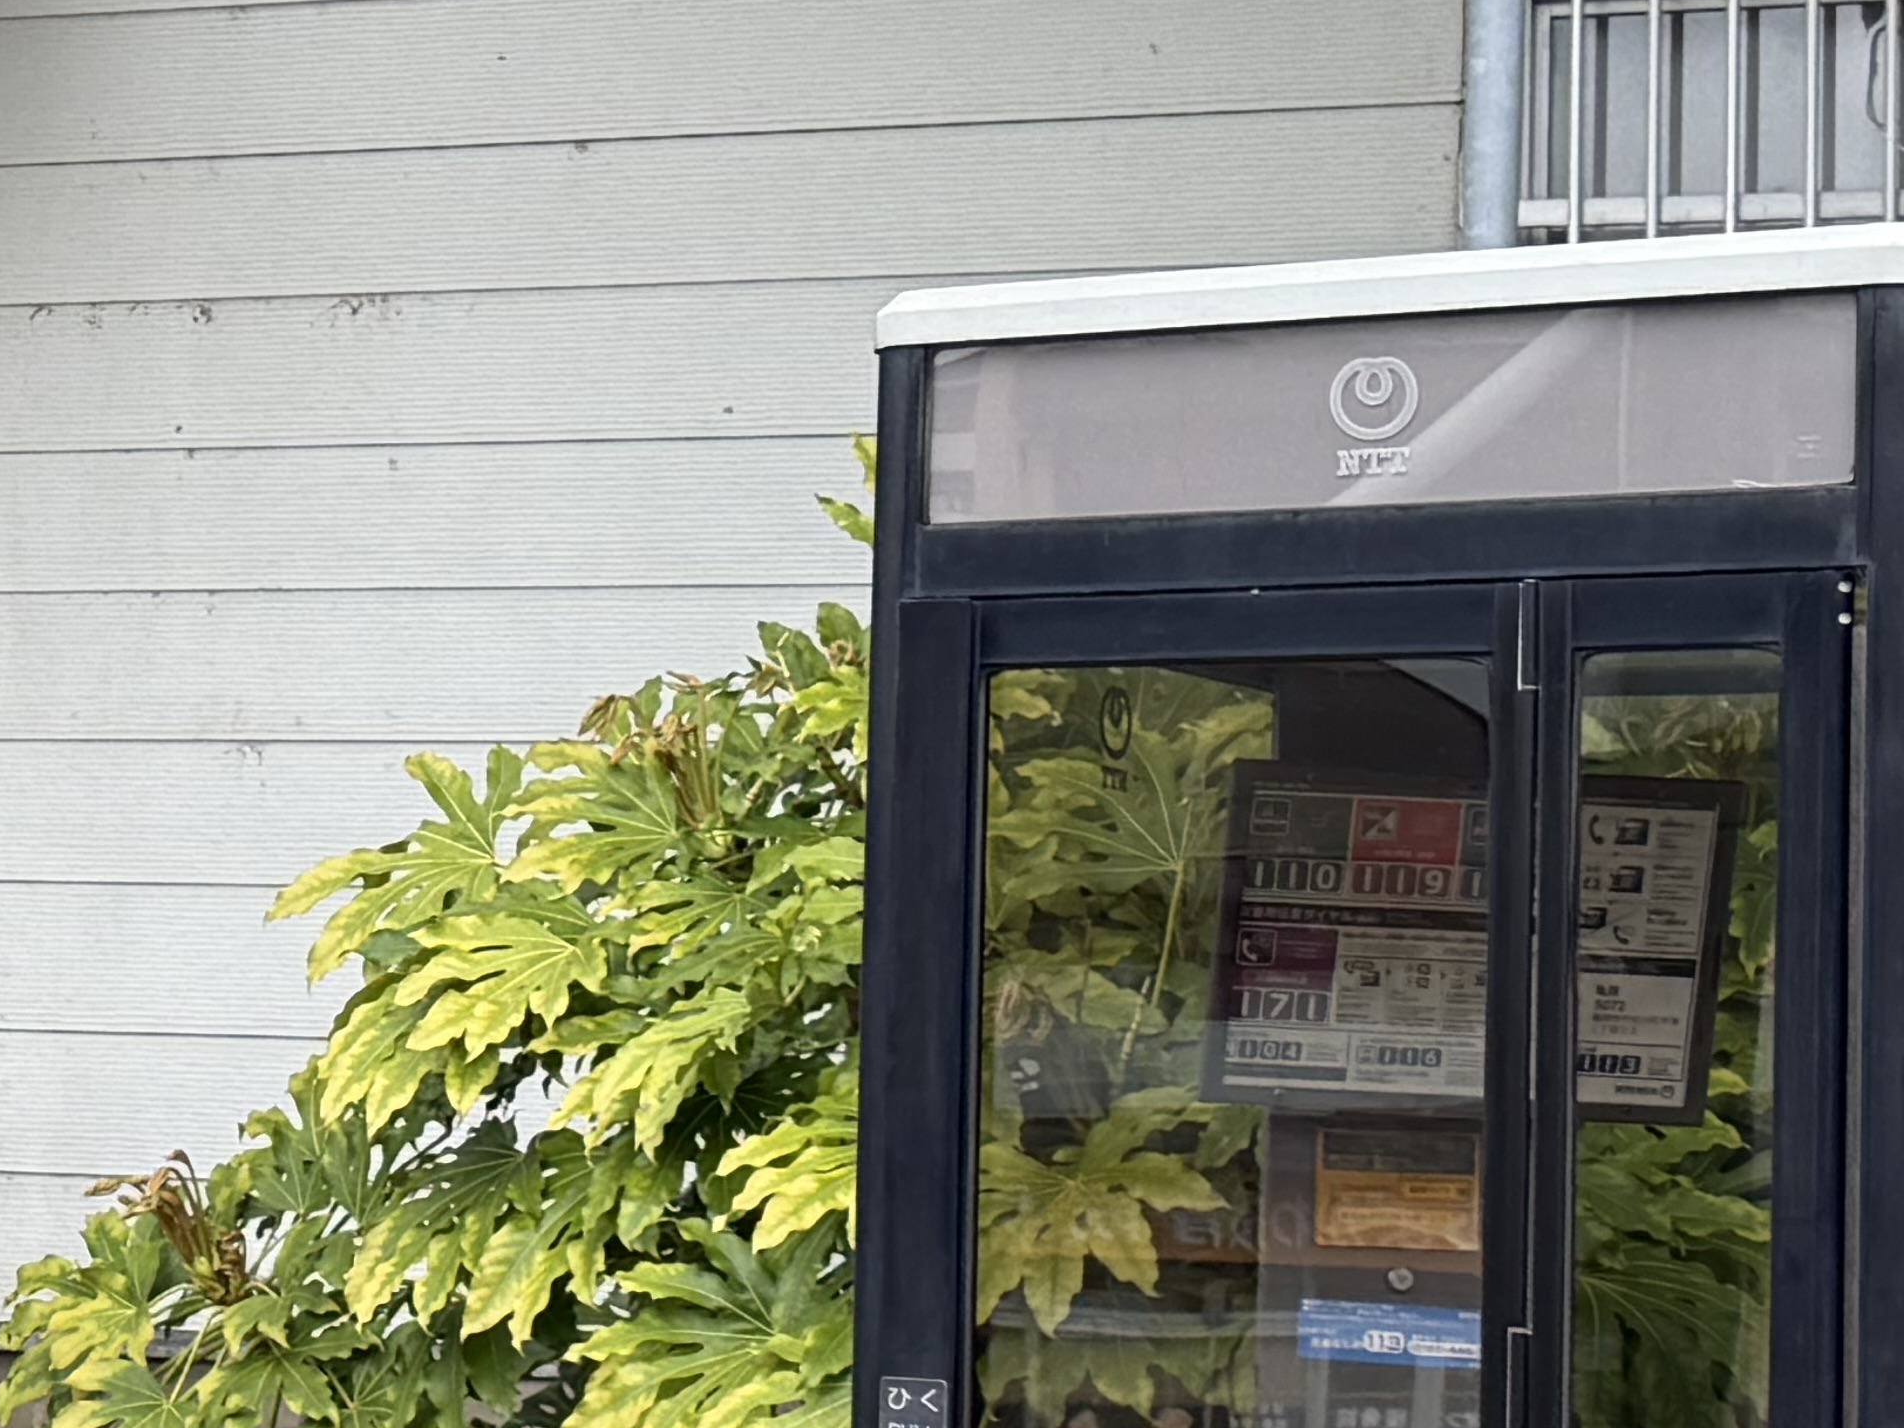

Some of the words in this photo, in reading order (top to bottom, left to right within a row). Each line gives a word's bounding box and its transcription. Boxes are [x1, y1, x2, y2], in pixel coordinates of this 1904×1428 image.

[1336, 446, 1411, 477] NTT
[1253, 860, 1336, 891] 110
[1362, 865, 1445, 894] 119
[1240, 992, 1316, 1020] 171
[1244, 1041, 1300, 1061] 104
[1383, 1048, 1438, 1066] 116
[1583, 1055, 1636, 1073] 113
[887, 1386, 939, 1413] ひく
